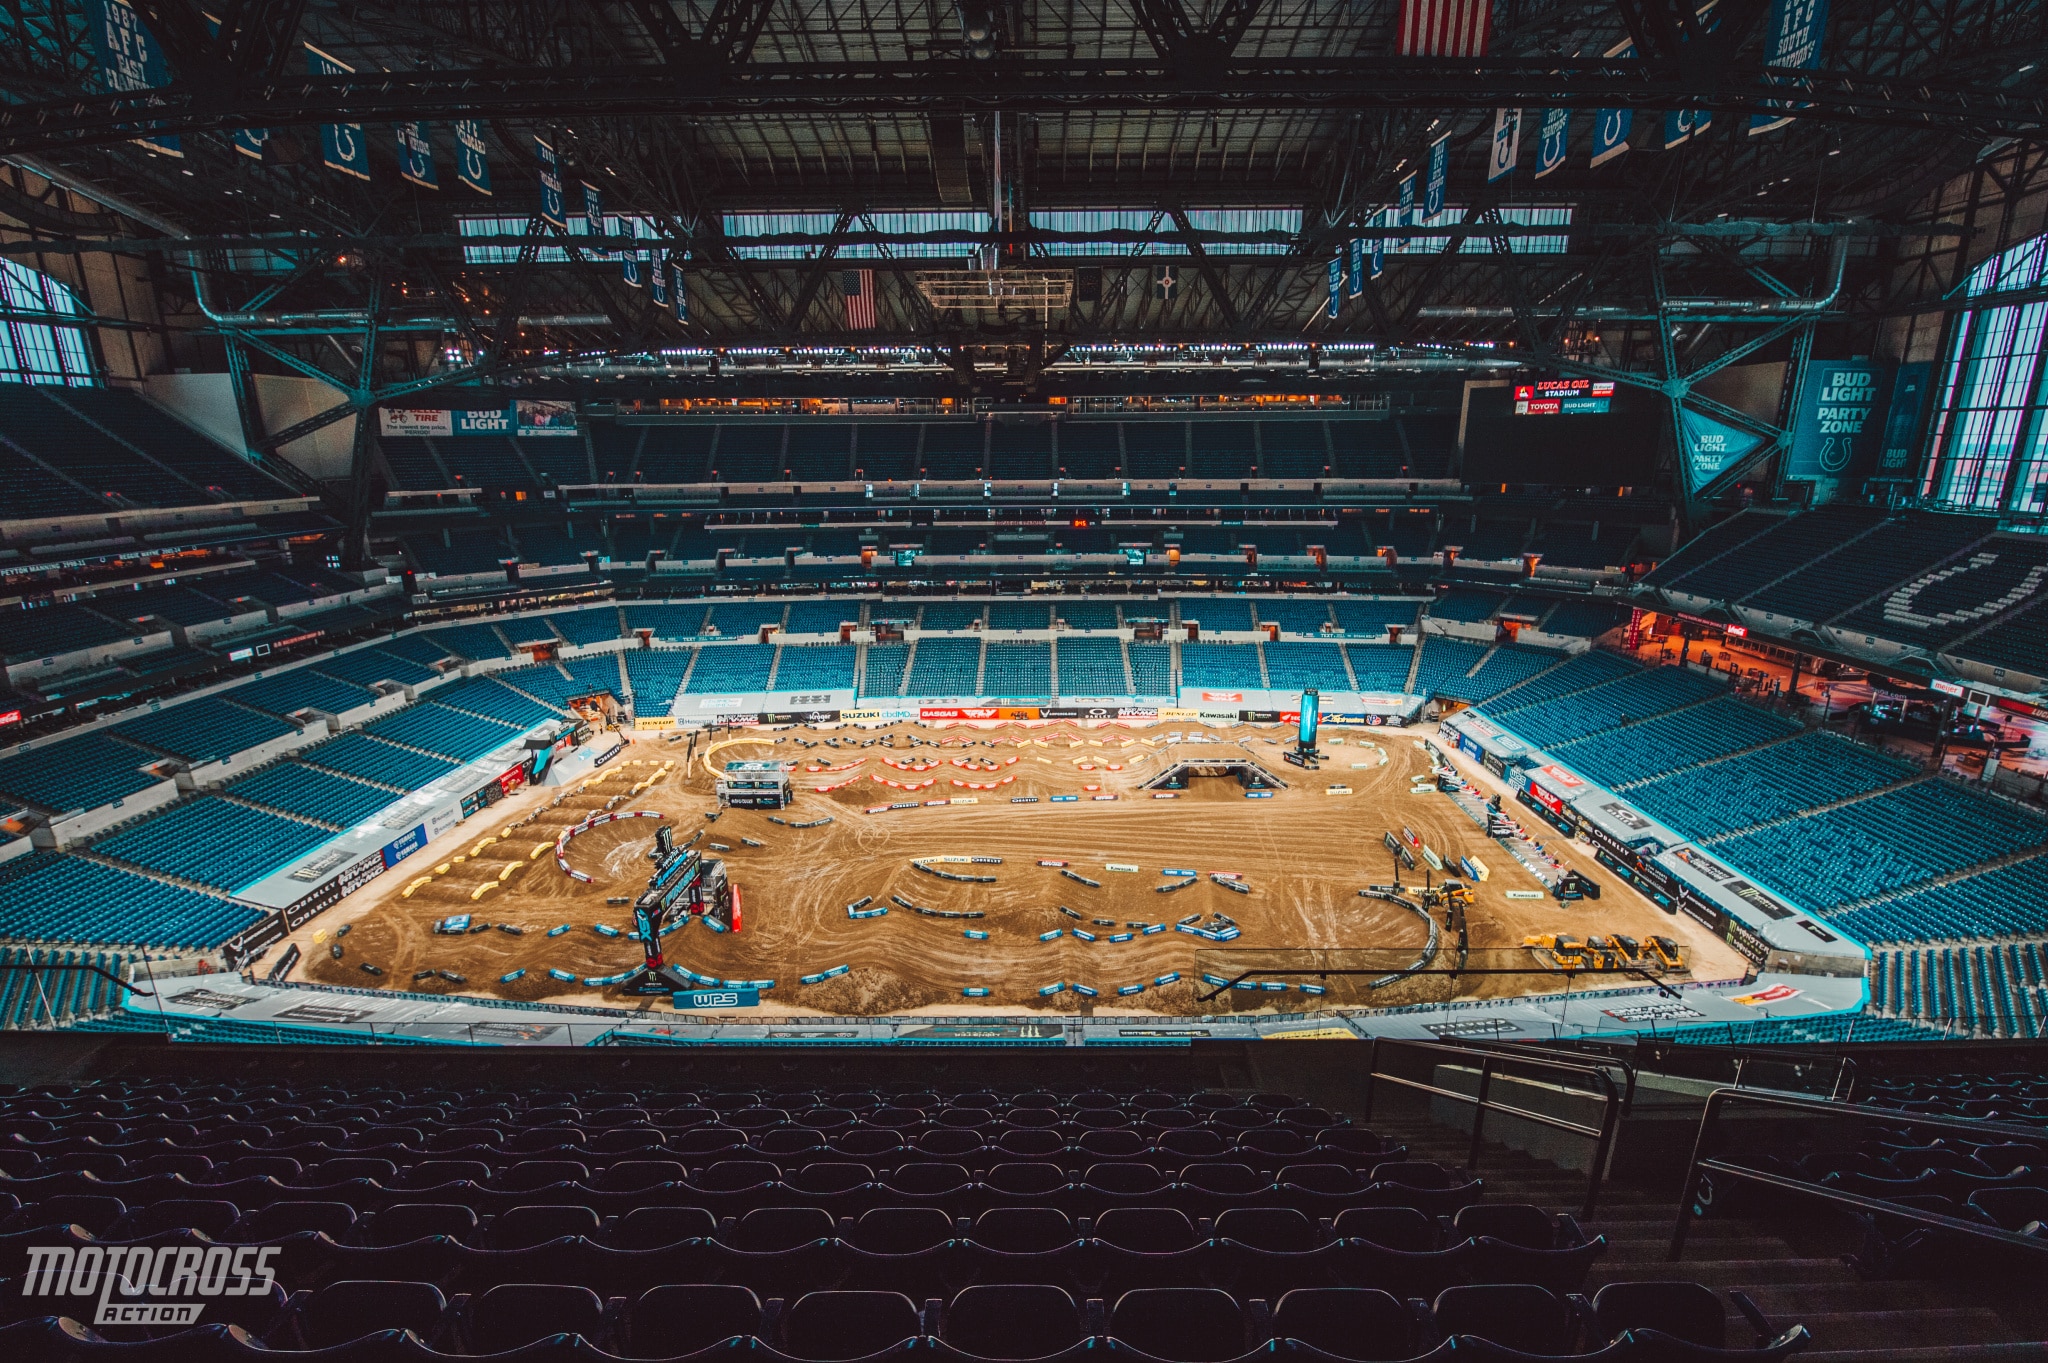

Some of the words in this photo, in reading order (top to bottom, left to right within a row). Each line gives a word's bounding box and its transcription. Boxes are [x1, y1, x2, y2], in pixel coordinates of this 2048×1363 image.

[104, 1, 137, 32] 1987
[1780, 0, 1815, 37] AFC
[106, 20, 147, 62] AFC
[1776, 25, 1810, 56] SOUTH
[1537, 380, 1570, 391] LUCAS
[1571, 380, 1590, 389] OIL
[1832, 372, 1871, 387] BUD
[1821, 387, 1876, 402] LIGHT
[467, 410, 501, 419] BUD
[1817, 407, 1871, 420] PARTY
[461, 418, 509, 430] LIGHT
[1820, 421, 1862, 434] ZONE
[1701, 435, 1724, 444] BUD
[1695, 443, 1727, 452] LIGHT
[1886, 449, 1907, 458] BUD
[1693, 455, 1724, 463] PARTY
[1882, 458, 1907, 468] LIGHT
[1695, 462, 1720, 471] ZONE
[1, 567, 29, 577] PEYTON
[29, 563, 61, 574] MANNING
[1935, 682, 1957, 694] meijer
[809, 712, 831, 722] Kroger
[841, 711, 880, 719] SUZUKI
[1607, 808, 1634, 826] OAKLEY
[400, 831, 416, 845] YAMAHA
[401, 842, 418, 857] YAMAHA
[1603, 836, 1630, 857] OAKLEY
[300, 881, 336, 907] OAKLEY
[303, 894, 339, 919] OAKLEY
[1687, 894, 1716, 917] AIRFORCE.COM
[1683, 907, 1713, 930] AIRFORCE.COM
[1736, 925, 1769, 955] MONSTER
[1734, 938, 1763, 964] MONSTE
[693, 993, 738, 1007] WPS
